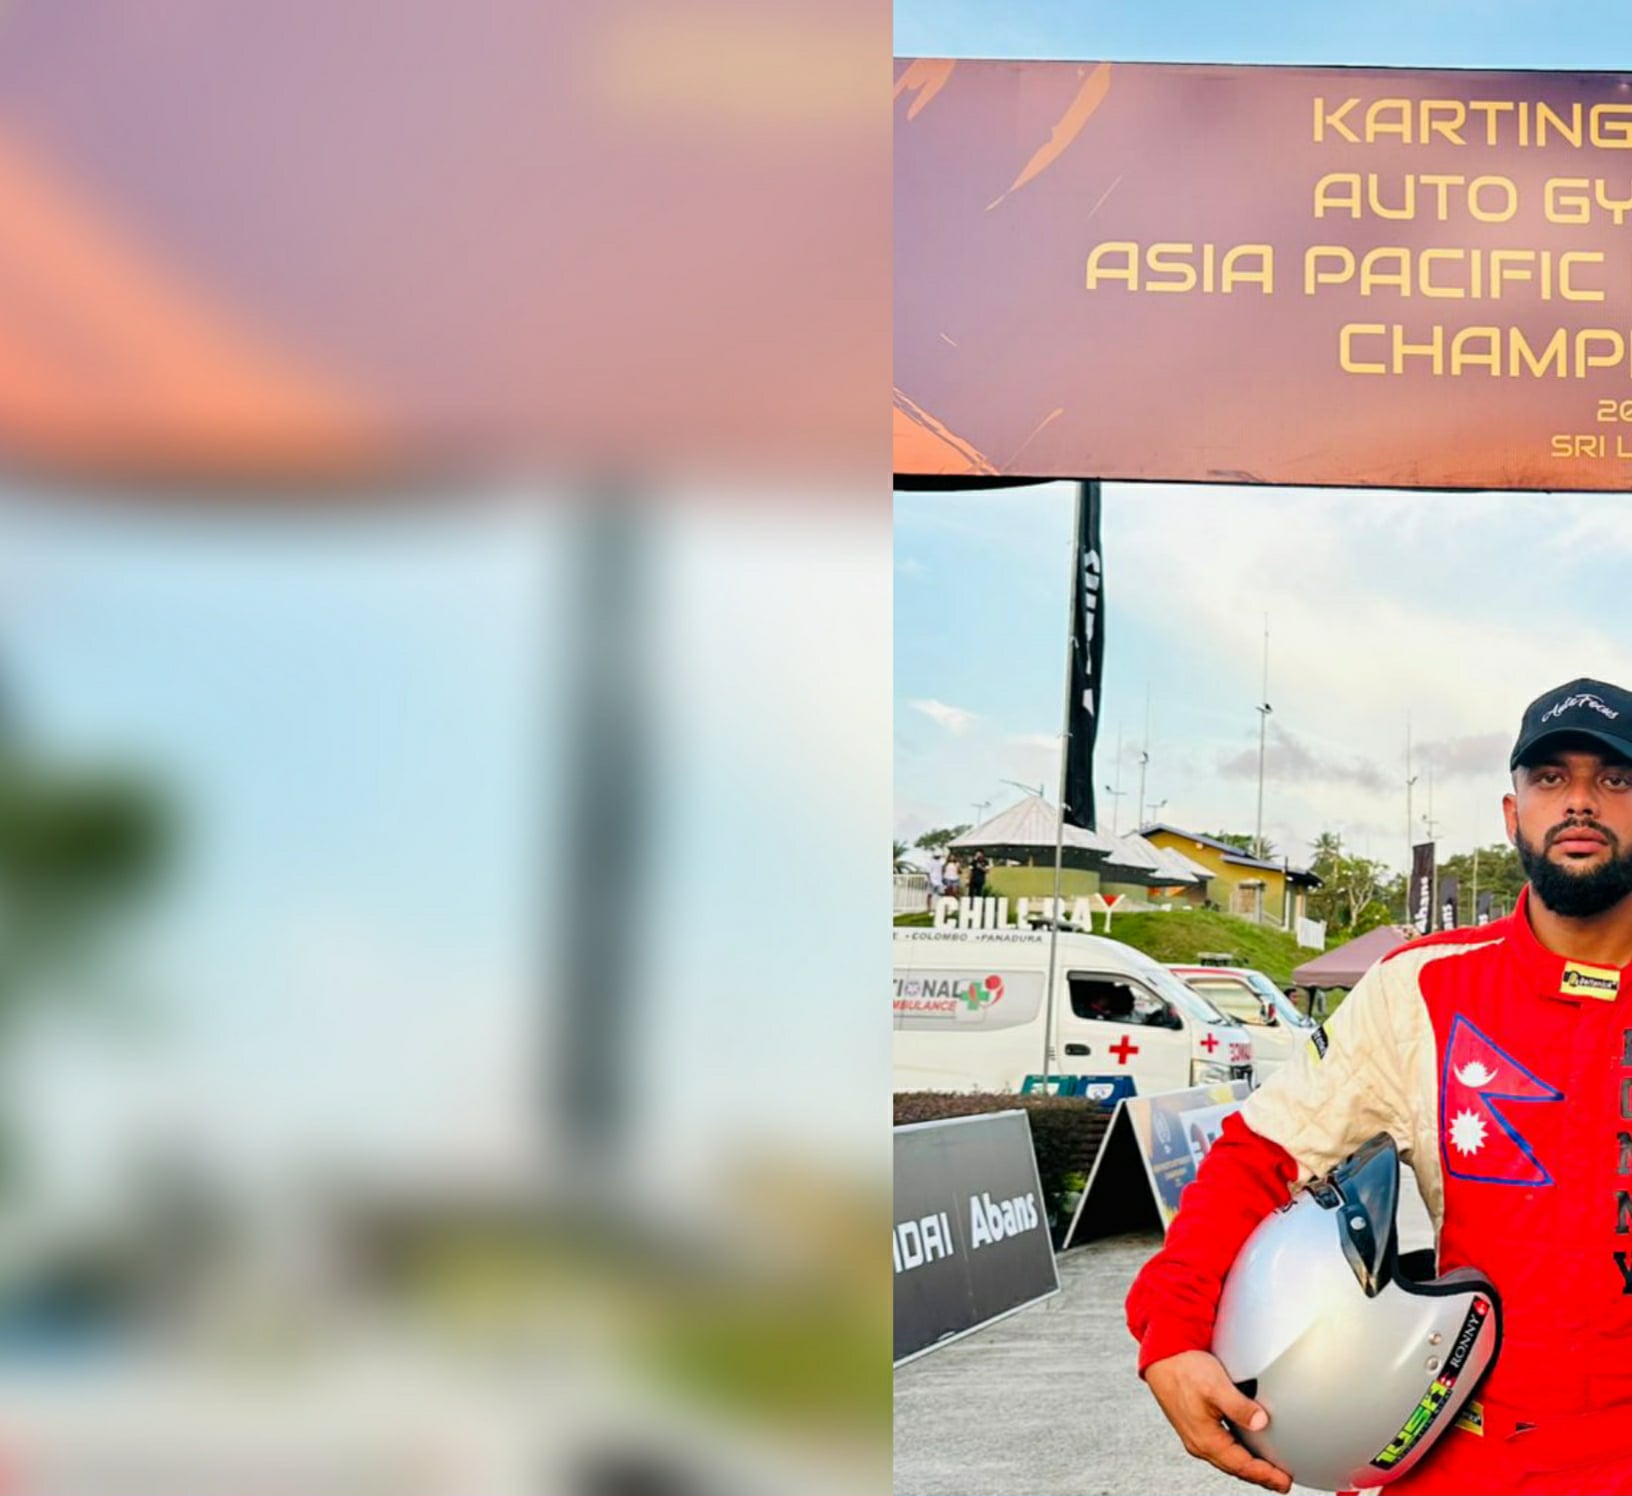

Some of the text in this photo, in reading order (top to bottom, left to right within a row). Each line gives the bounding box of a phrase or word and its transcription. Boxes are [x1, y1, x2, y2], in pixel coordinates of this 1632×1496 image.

[1313, 173, 1518, 223] AUTO
[1085, 241, 1275, 294] ASIA
[1304, 246, 1605, 301] PACIFIC
[1550, 434, 1605, 458] SRI
[969, 1192, 1039, 1249] Abans
[1450, 1313, 1480, 1369] RONNY
